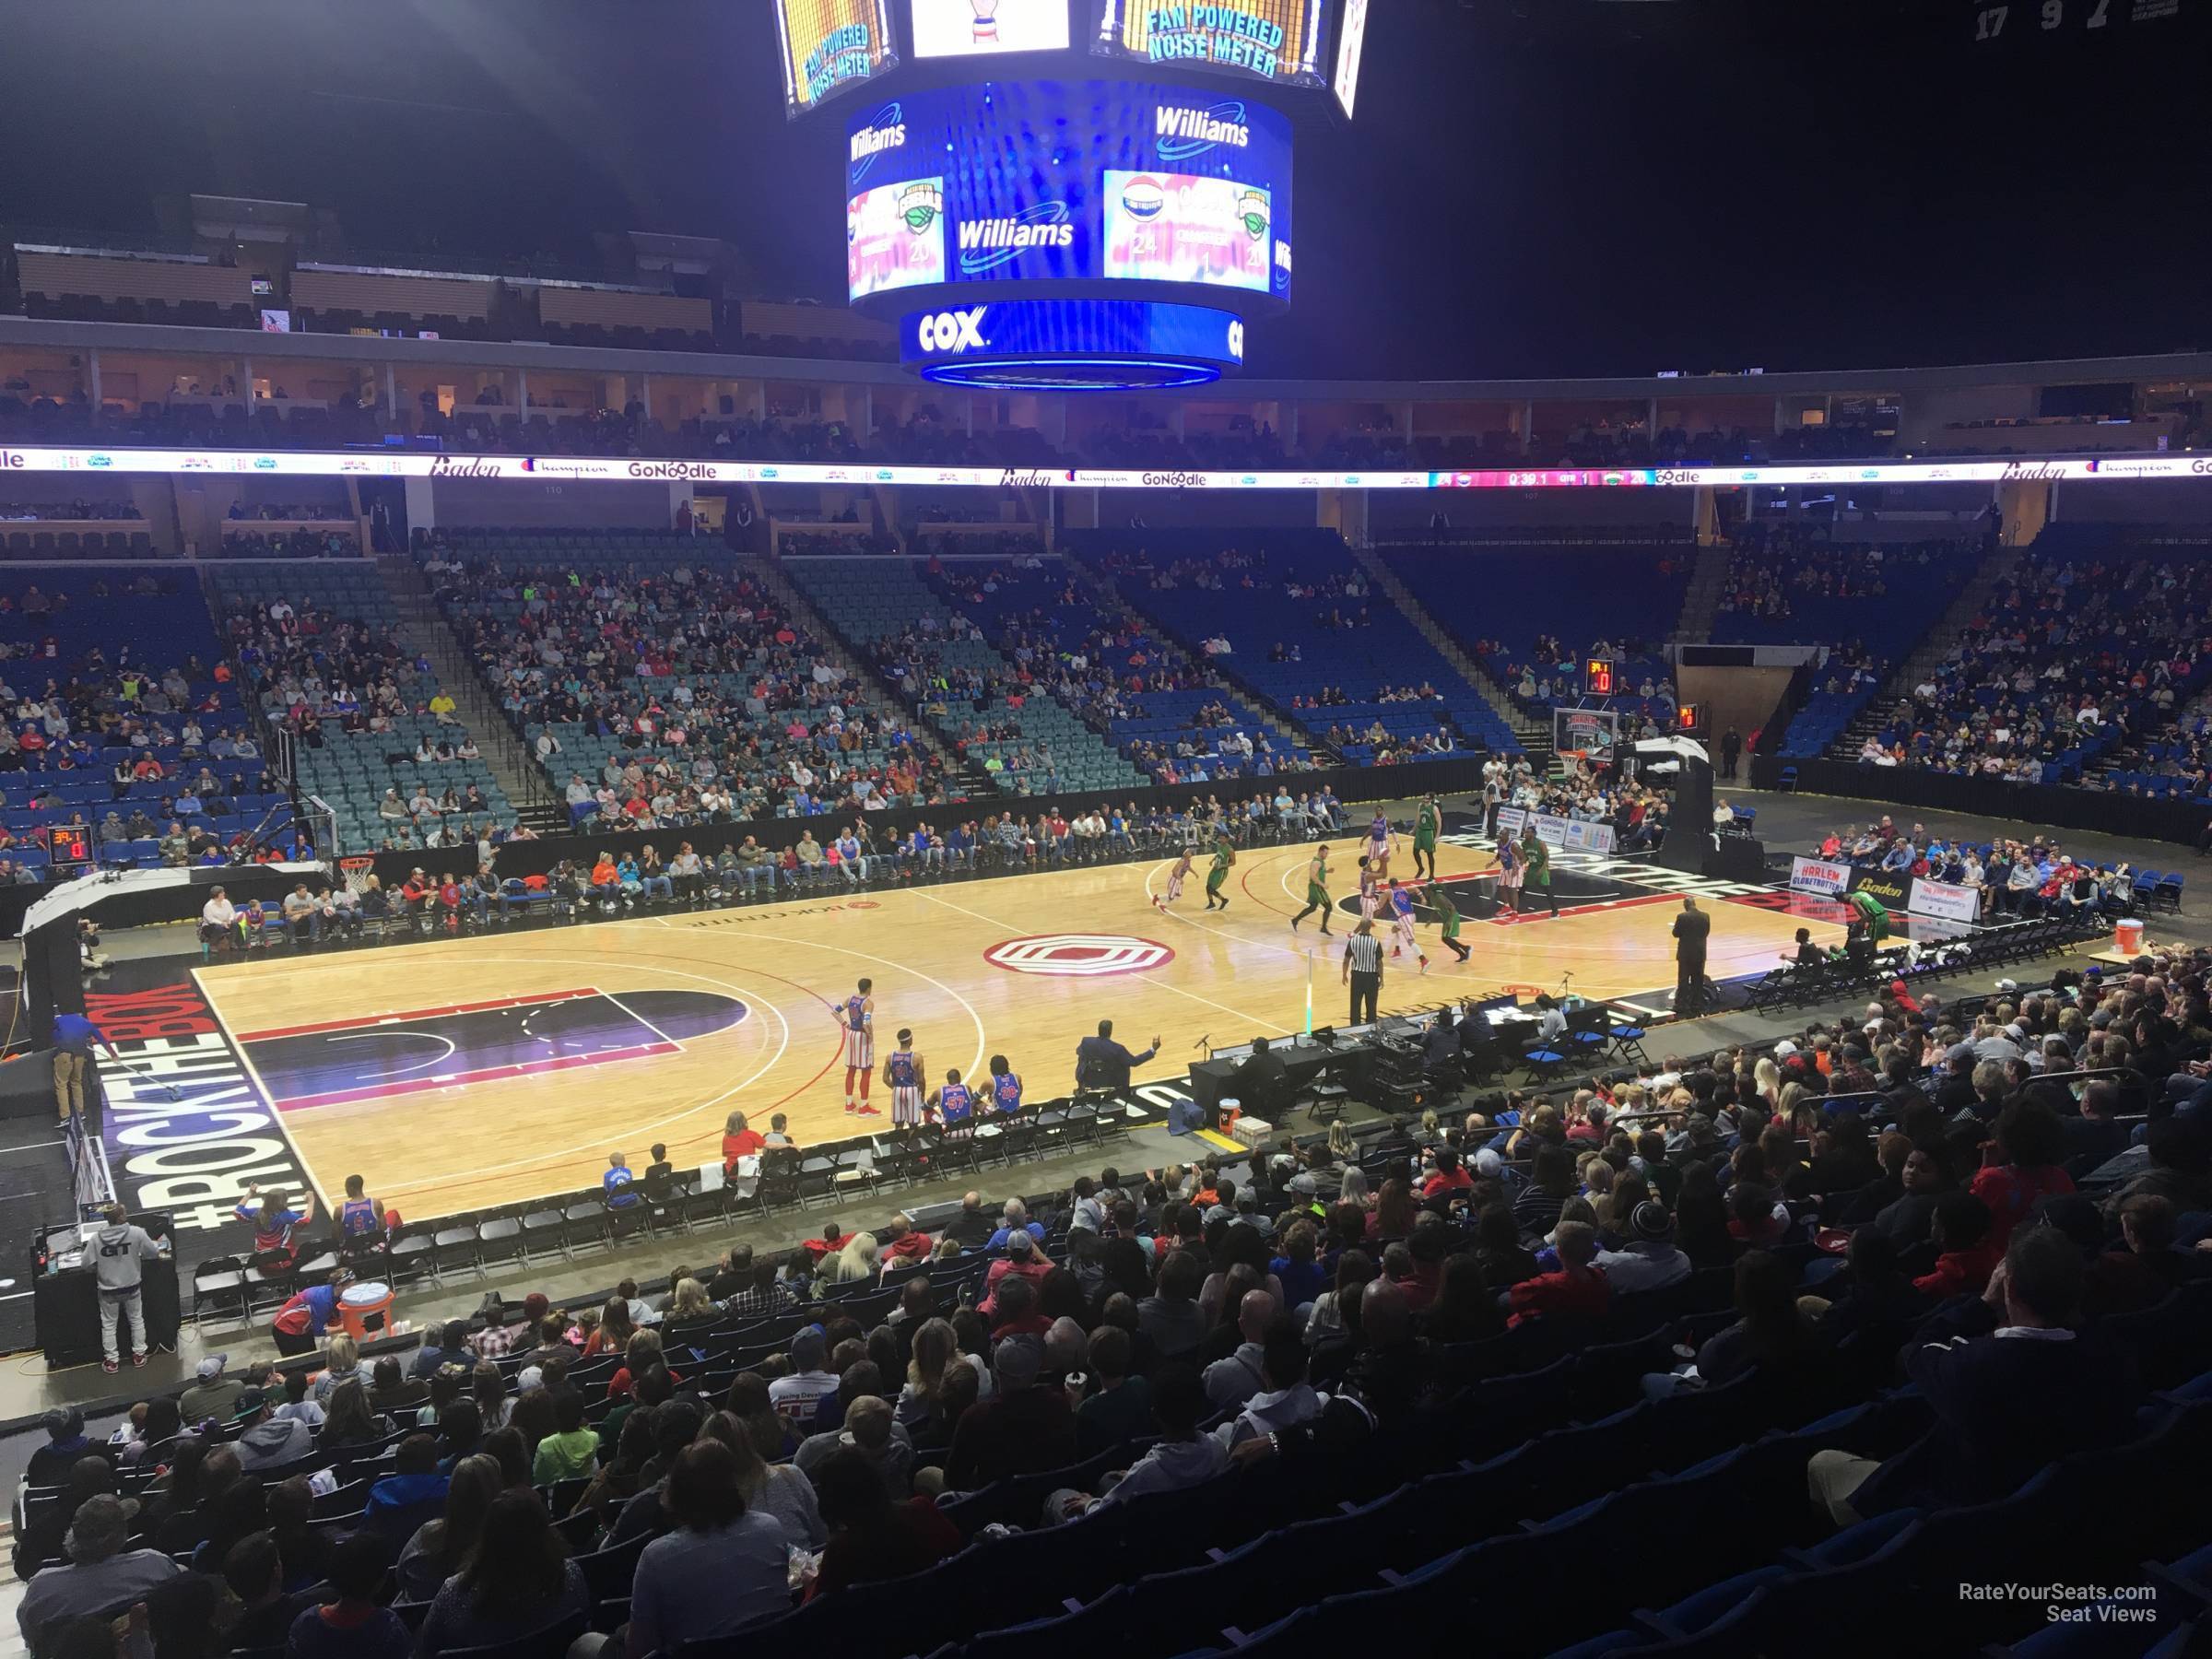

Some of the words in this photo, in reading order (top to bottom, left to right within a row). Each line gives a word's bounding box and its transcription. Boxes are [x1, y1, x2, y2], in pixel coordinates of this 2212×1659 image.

[1147, 6, 1186, 33] FAN
[1192, 6, 1283, 50] POWERED
[1976, 6, 2008, 41] 17
[803, 47, 822, 82] FAN
[821, 23, 868, 57] POWERED
[1148, 35, 1206, 62] NOISE
[1213, 36, 1277, 78] METER
[808, 63, 835, 105] NOISE
[835, 52, 870, 79] METER
[1156, 105, 1249, 147] Williams
[851, 124, 906, 162] Williams
[959, 218, 1074, 250] Williams
[429, 456, 502, 478] Baden
[999, 467, 1052, 487] Baden
[2001, 461, 2066, 480] Baden
[1592, 663, 1608, 673] 39.1
[54, 831, 80, 844] 39.1
[1802, 865, 1841, 881] HARLEM
[1793, 877, 1843, 892] GLOBETROTTERS
[1856, 877, 1903, 898] Baden
[947, 1097, 965, 1110] 57
